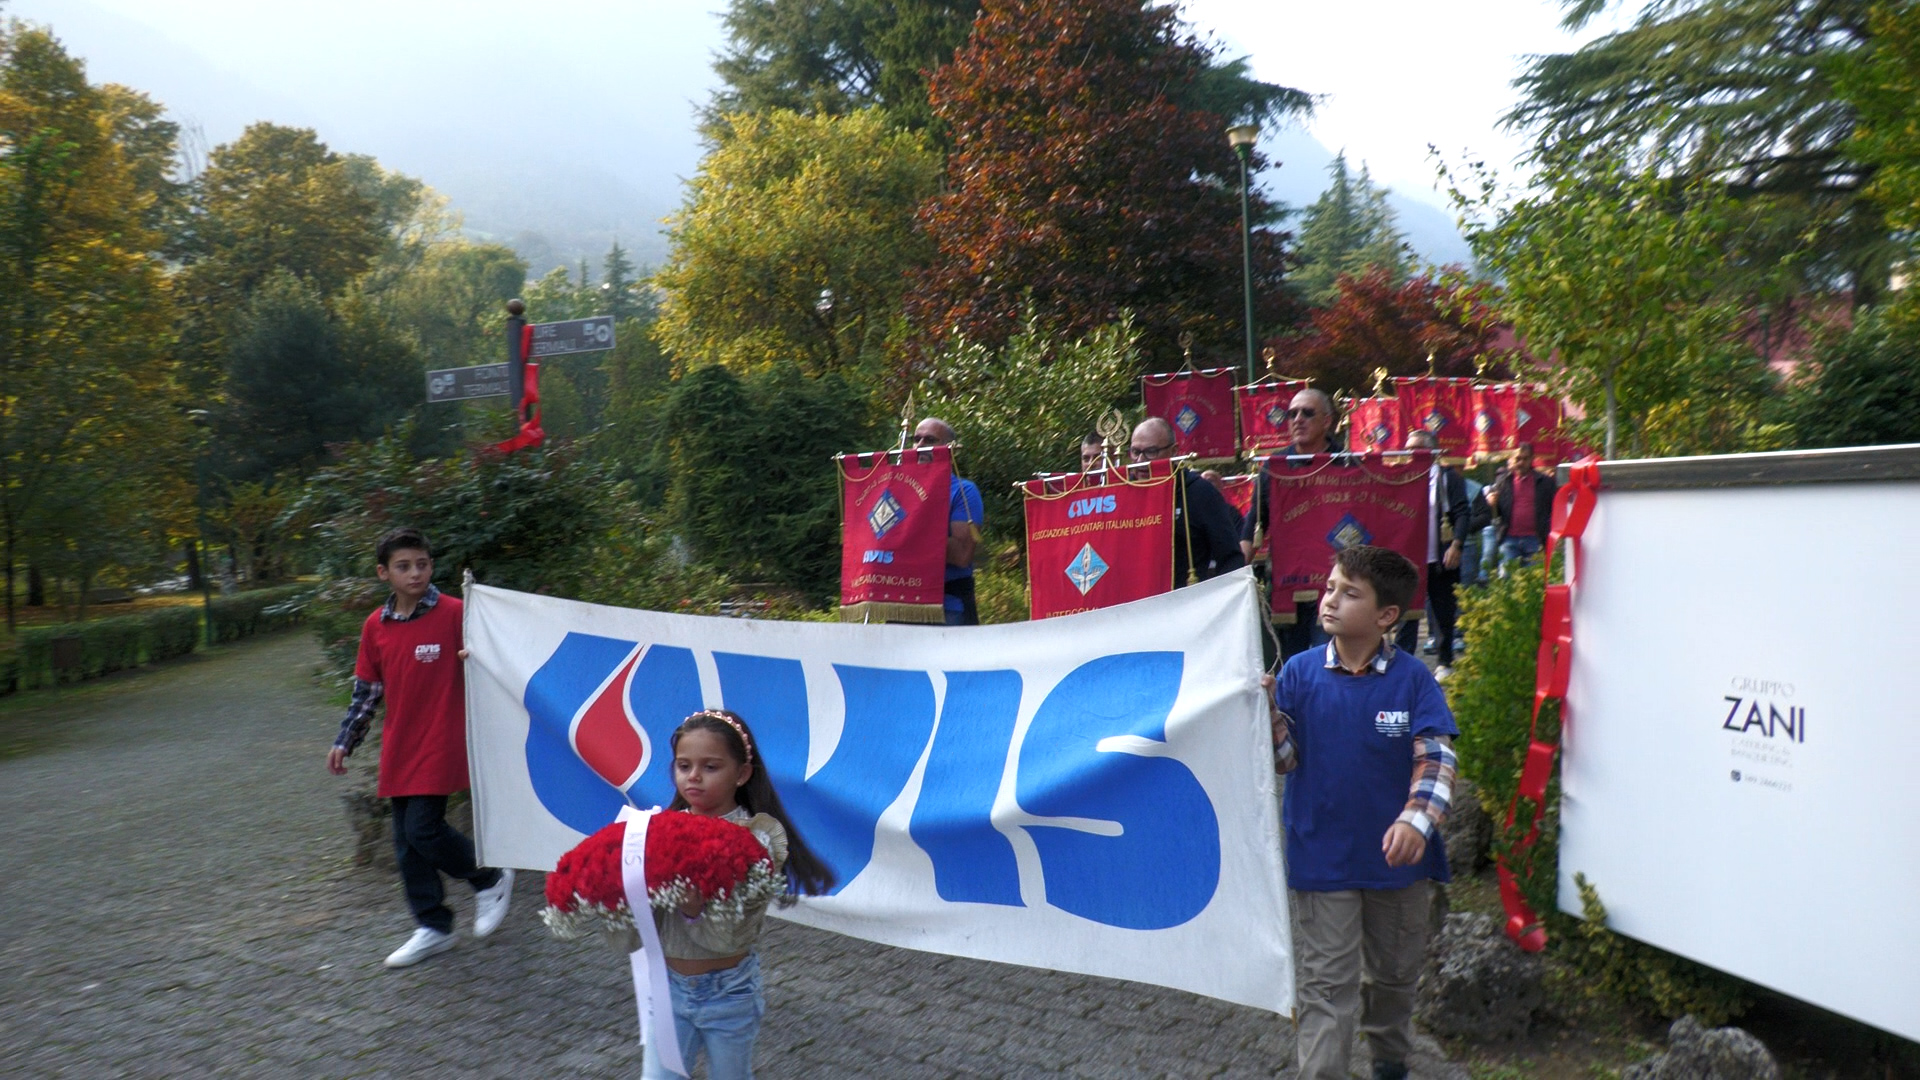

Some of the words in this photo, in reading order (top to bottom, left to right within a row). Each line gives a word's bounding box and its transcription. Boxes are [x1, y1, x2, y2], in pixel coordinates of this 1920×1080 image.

[532, 325, 558, 339] URE
[531, 337, 577, 354] ERMALI
[1067, 494, 1118, 519] AVIS
[1031, 527, 1069, 541] ASSOCIAZIONE
[1070, 521, 1105, 535] VOLONTARI
[1105, 519, 1134, 530] ITALIANI
[1134, 514, 1162, 528] SANGUE
[862, 550, 895, 565] AVIS
[415, 644, 441, 654] AVIS
[1375, 711, 1409, 723] AVIS
[1722, 695, 1805, 744] ZANI
[524, 632, 1221, 931] AVIS
